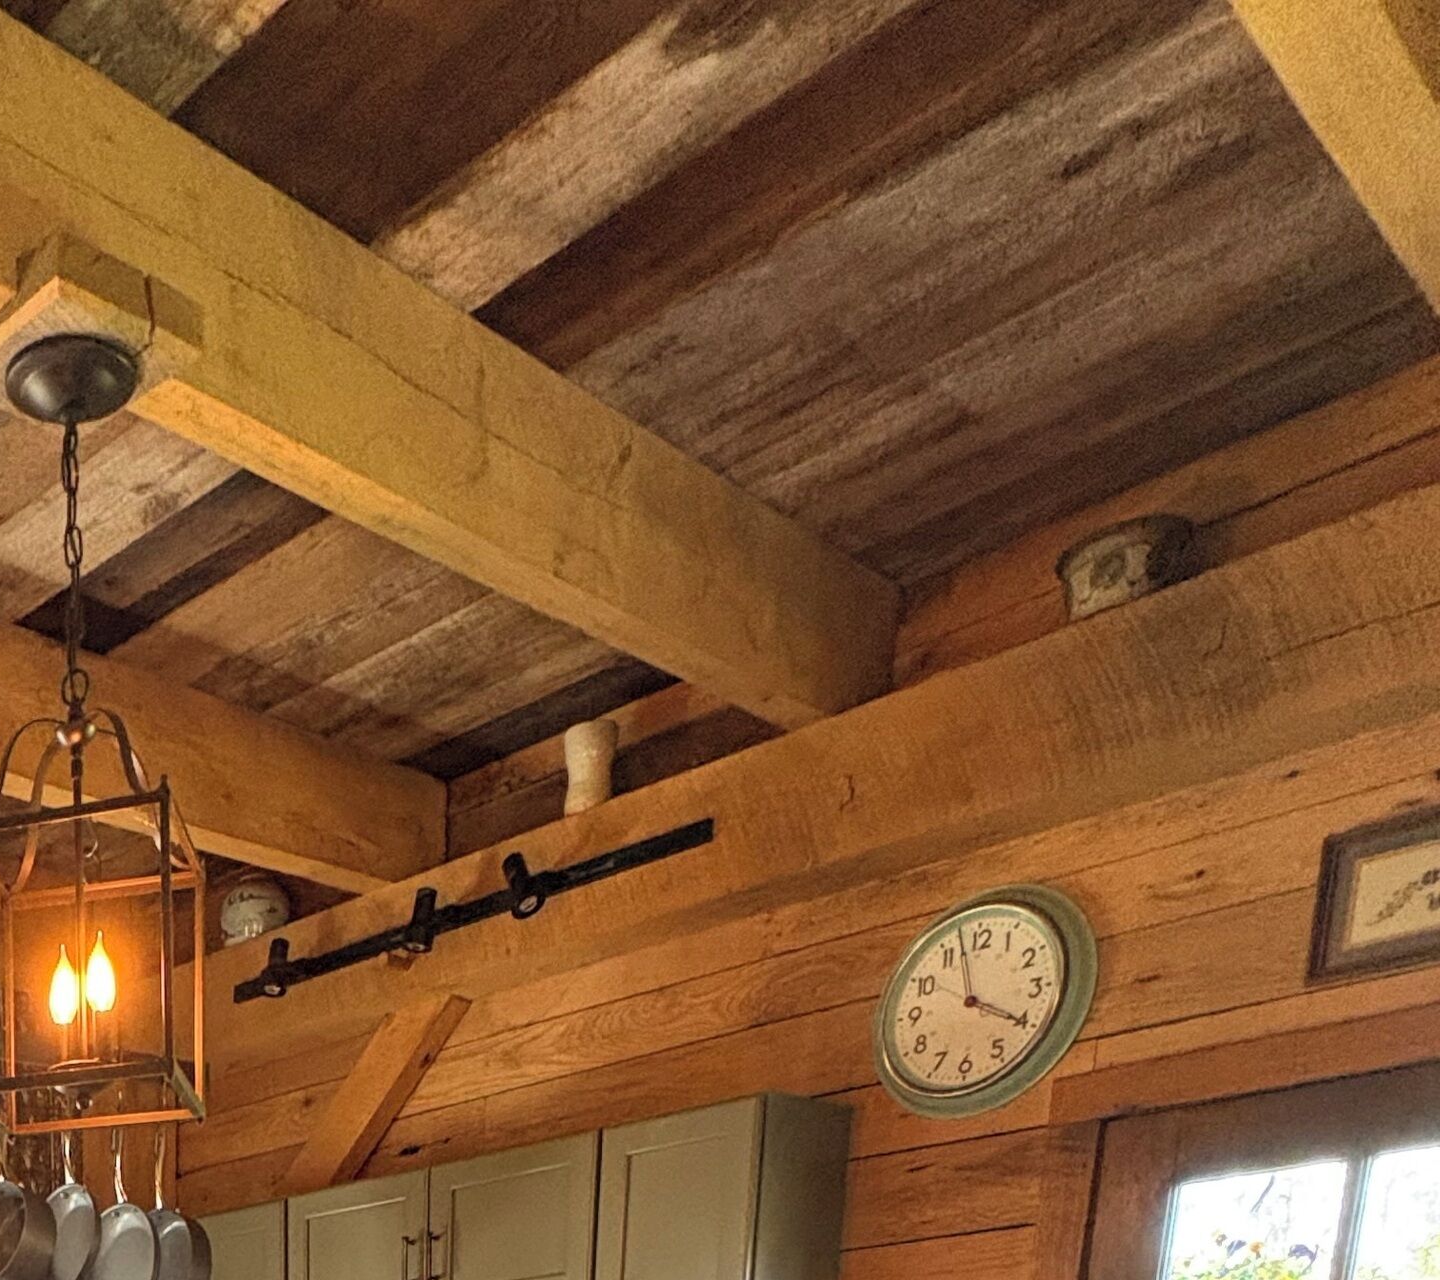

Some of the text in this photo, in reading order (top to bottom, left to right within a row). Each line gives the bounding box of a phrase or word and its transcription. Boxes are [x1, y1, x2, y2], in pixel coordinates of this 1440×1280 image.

[972, 929, 992, 951] 12
[942, 948, 954, 968] 11
[1022, 948, 1036, 968] 2
[917, 975, 935, 998] 10
[1028, 977, 1042, 998] 3
[908, 1006, 922, 1026] 9
[1014, 1010, 1028, 1029] 4
[913, 1034, 927, 1054] 8
[990, 1038, 1004, 1059] 5
[933, 1051, 949, 1072] 7
[958, 1054, 973, 1074] 6
